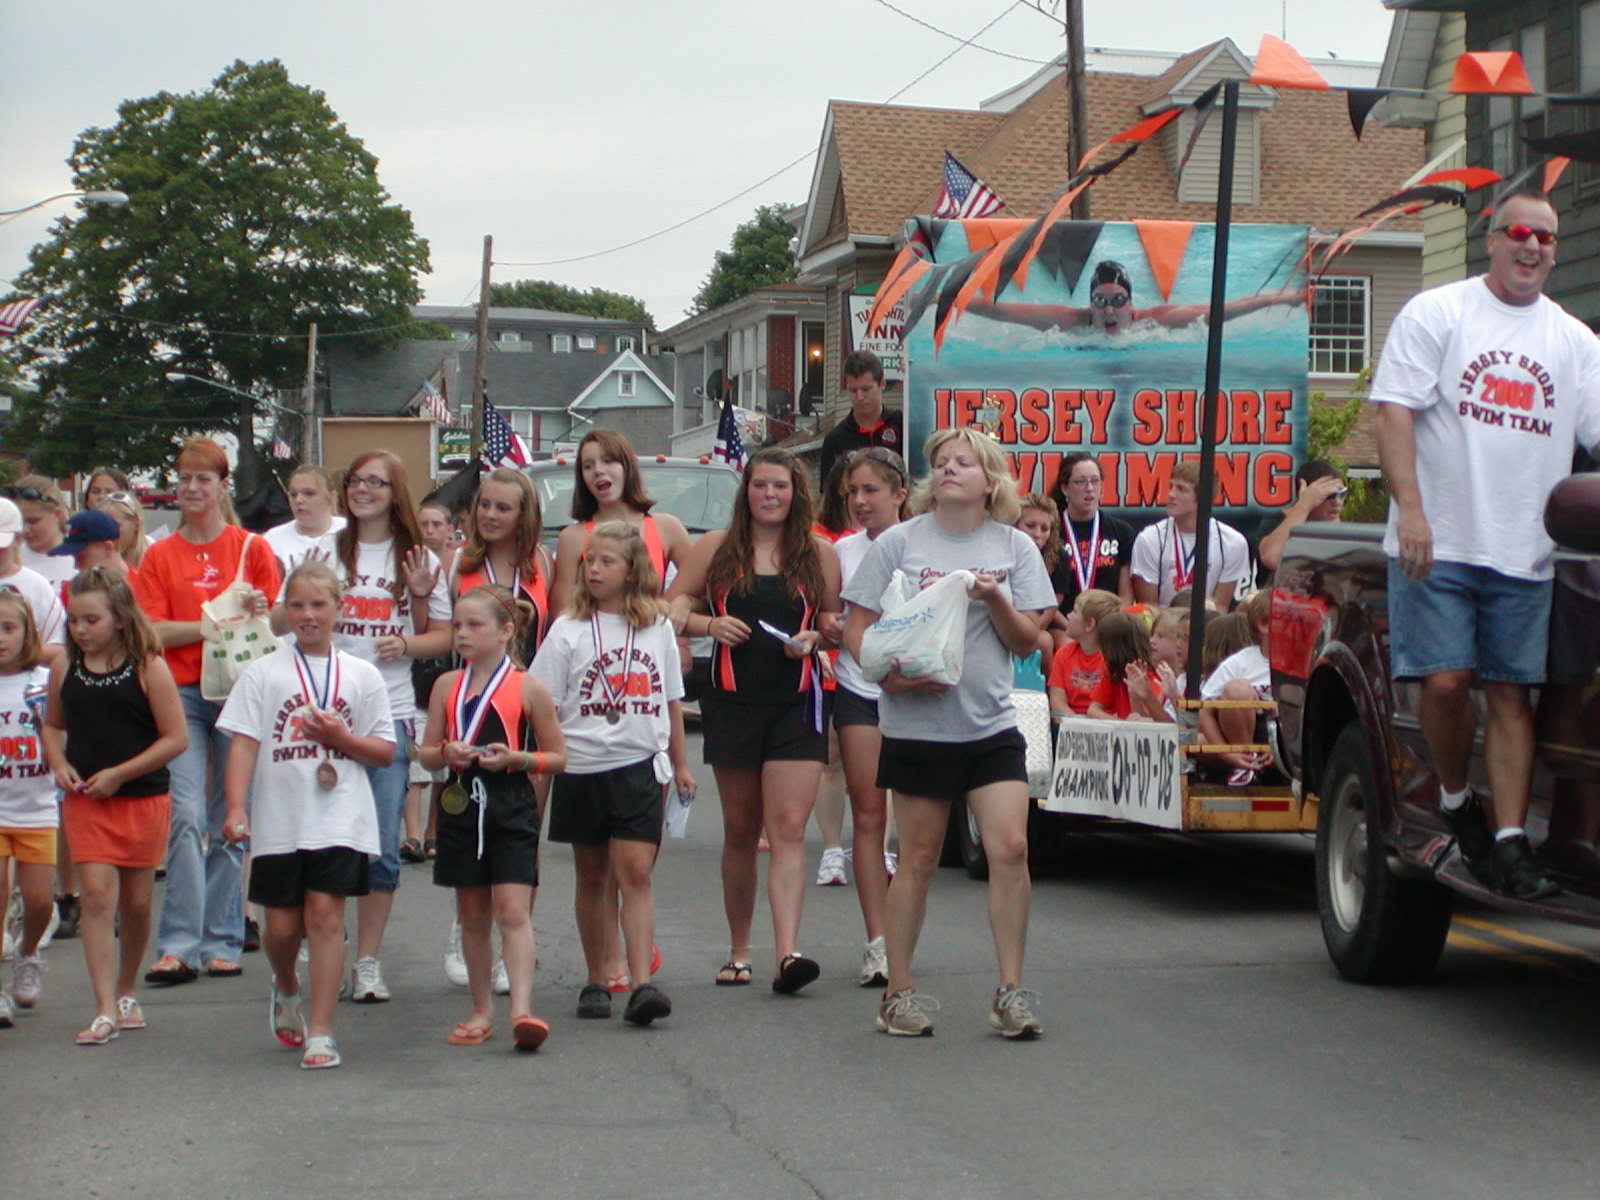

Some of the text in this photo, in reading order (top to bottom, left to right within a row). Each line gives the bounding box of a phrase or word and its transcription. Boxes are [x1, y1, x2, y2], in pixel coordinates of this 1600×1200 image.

[860, 342, 904, 352] FINE FOO
[1459, 350, 1555, 409] JERSEY SHORE
[1480, 373, 1535, 411] 2008
[935, 389, 1114, 443] JERSEY
[1459, 401, 1552, 437] SWIM TEAM
[341, 595, 393, 621] 2008
[631, 648, 662, 694] SHORE
[272, 693, 306, 743] JERSE
[272, 744, 318, 763] SWIM
